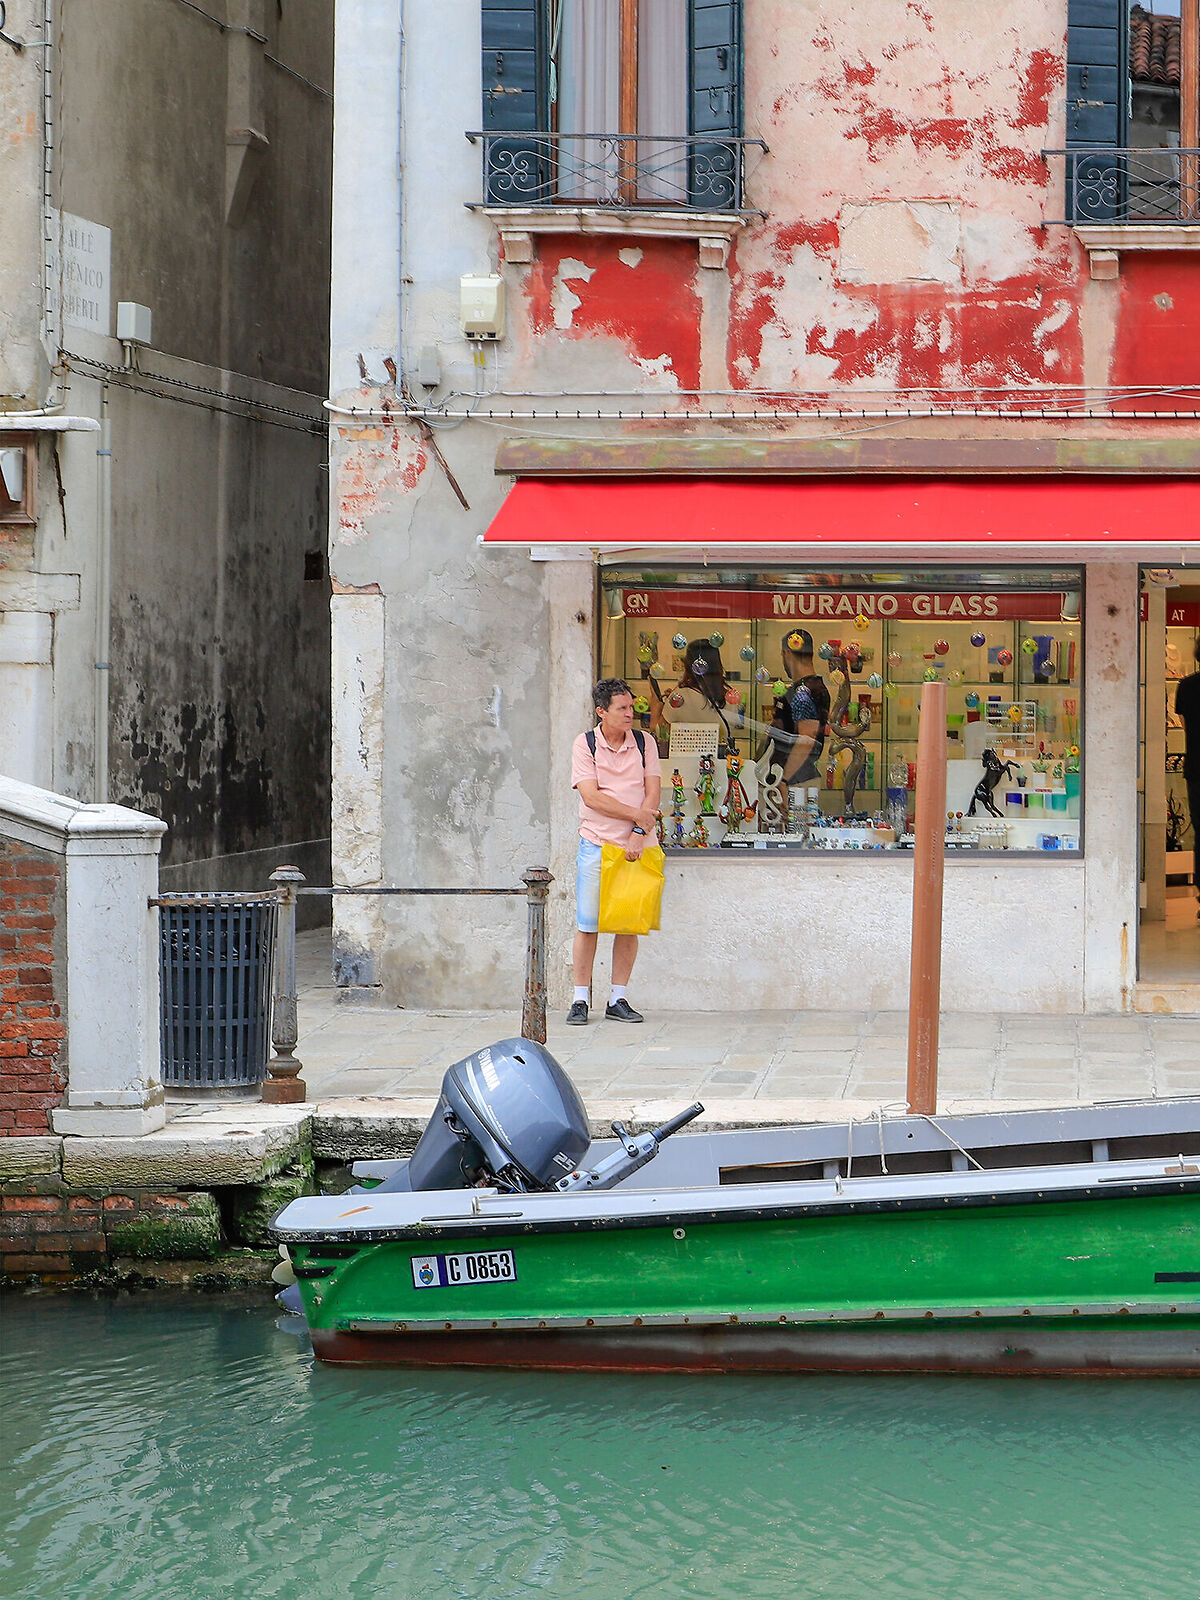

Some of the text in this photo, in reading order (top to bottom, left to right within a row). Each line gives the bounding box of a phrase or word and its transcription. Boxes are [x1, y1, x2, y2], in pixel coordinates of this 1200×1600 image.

[626, 593, 649, 608] GN
[772, 594, 999, 616] MURANO GLASS
[1171, 609, 1186, 621] AT
[479, 1053, 501, 1092] YAMAHA
[552, 1151, 577, 1172] 25
[448, 1252, 512, 1282] C 0853
